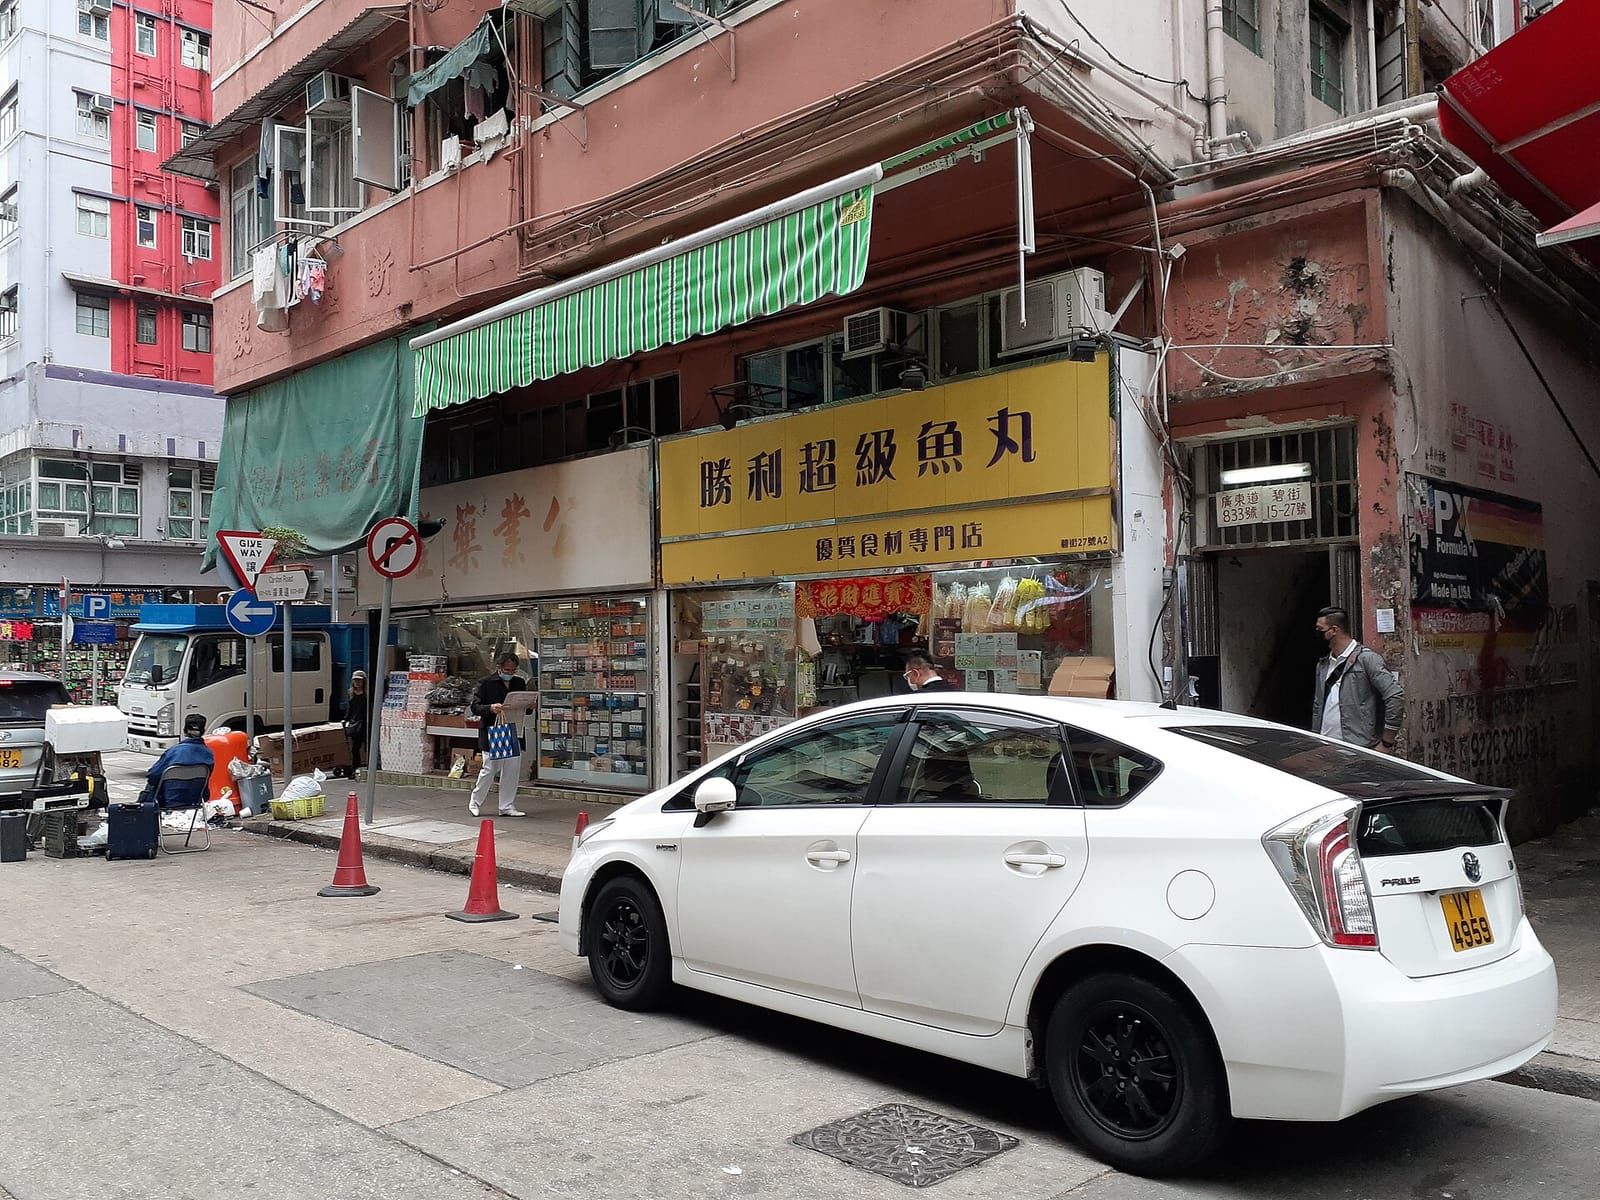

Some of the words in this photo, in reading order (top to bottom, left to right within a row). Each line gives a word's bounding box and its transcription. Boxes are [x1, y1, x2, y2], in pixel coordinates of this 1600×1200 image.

[699, 406, 1037, 508] 勝利超級魚丸
[1221, 491, 1260, 509] 廣東道
[1271, 487, 1302, 503] 碧街
[1222, 505, 1258, 524] 833號
[1266, 502, 1308, 519] 15-27號
[240, 540, 262, 548] GIVE
[815, 522, 983, 562] 優質食材專門店
[1436, 537, 1469, 558] Formula
[240, 549, 262, 557] WAY
[819, 581, 904, 608] 招財進寶
[1430, 582, 1451, 599] Made
[90, 597, 106, 617] P
[0, 751, 12, 759] U
[0, 759, 19, 768] 82
[1380, 876, 1421, 887] PRIUS
[1452, 891, 1473, 920] VY
[1454, 917, 1492, 948] 4959
